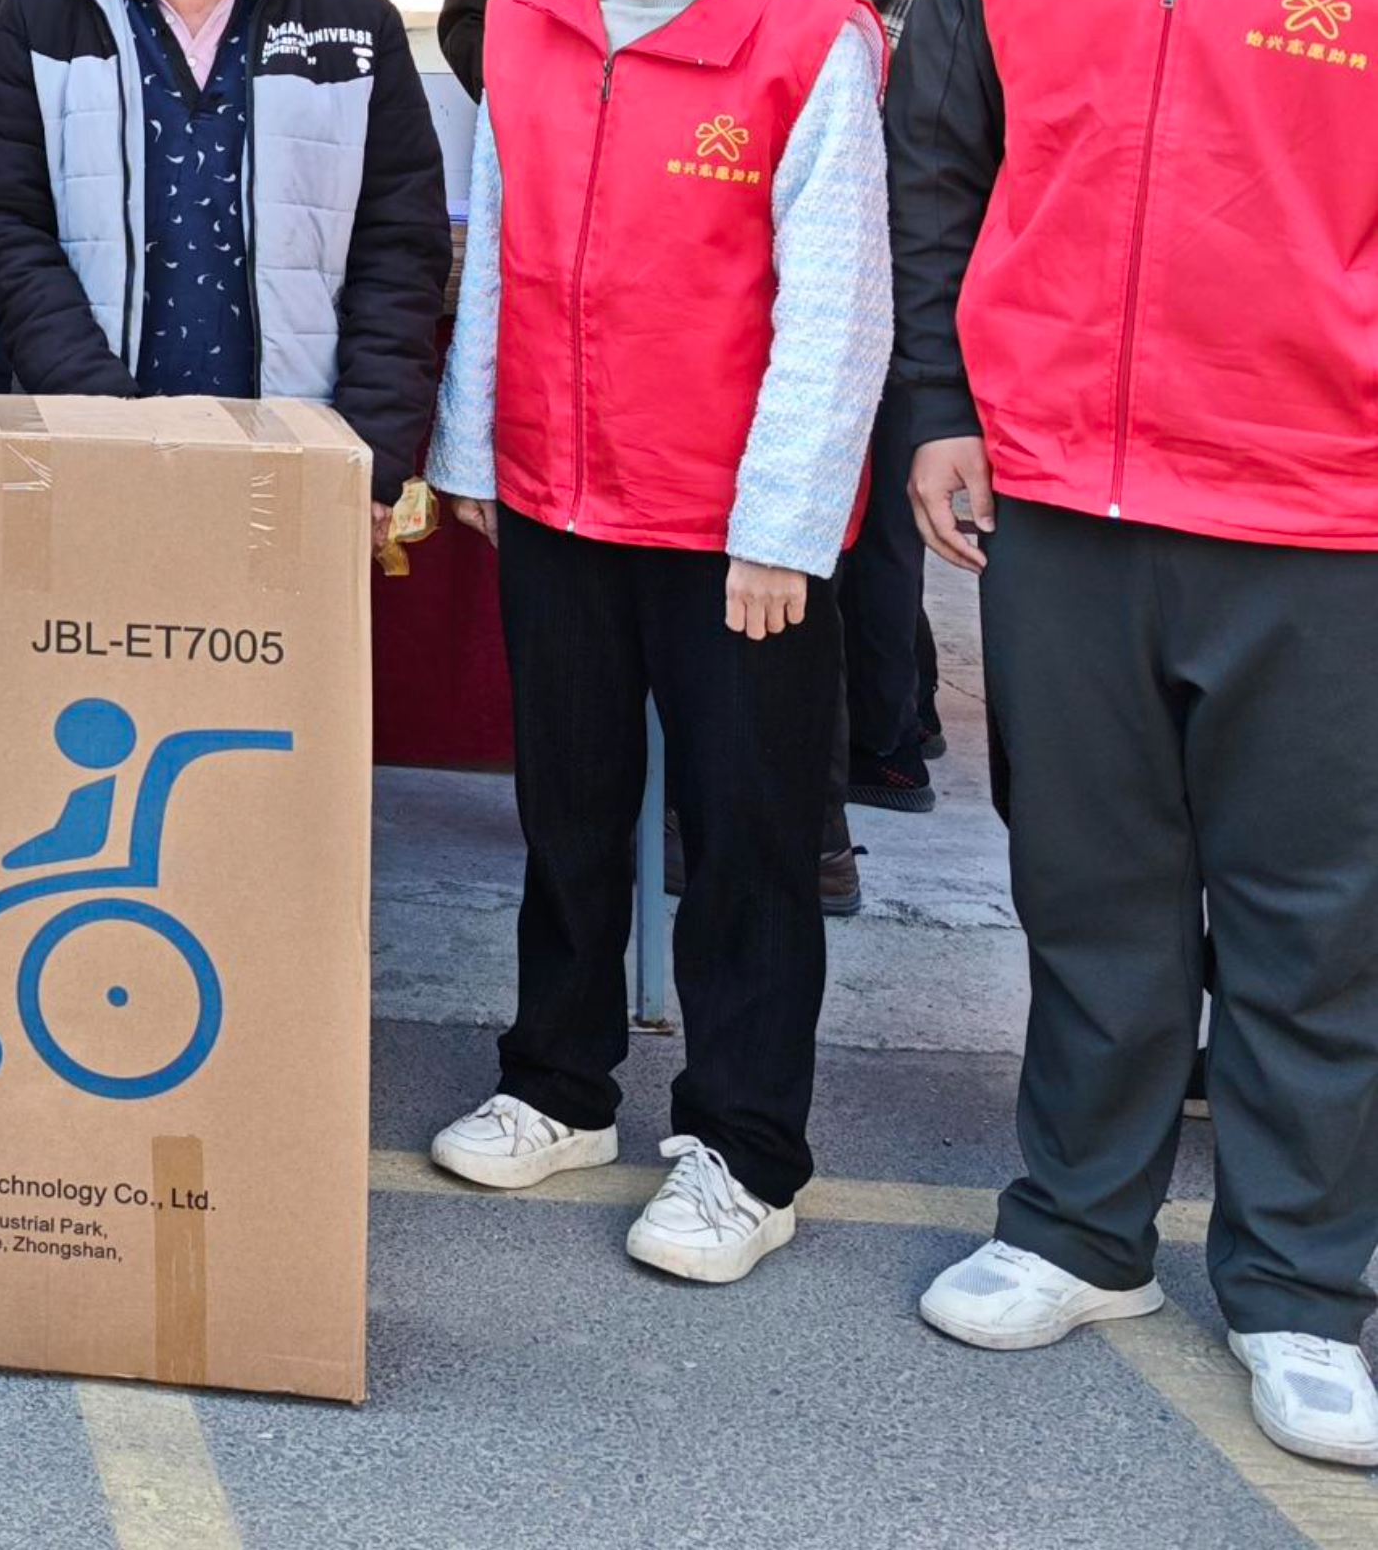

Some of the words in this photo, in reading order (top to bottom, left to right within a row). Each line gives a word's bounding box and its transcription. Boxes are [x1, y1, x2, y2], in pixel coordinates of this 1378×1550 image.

[305, 27, 373, 47] UNIVERSE
[31, 619, 285, 665] JBL-ET7005
[114, 1182, 164, 1210] Co.,
[171, 1187, 217, 1211] Ltd.
[60, 1217, 109, 1239] Park,
[13, 1236, 123, 1263] Zhongshan,
